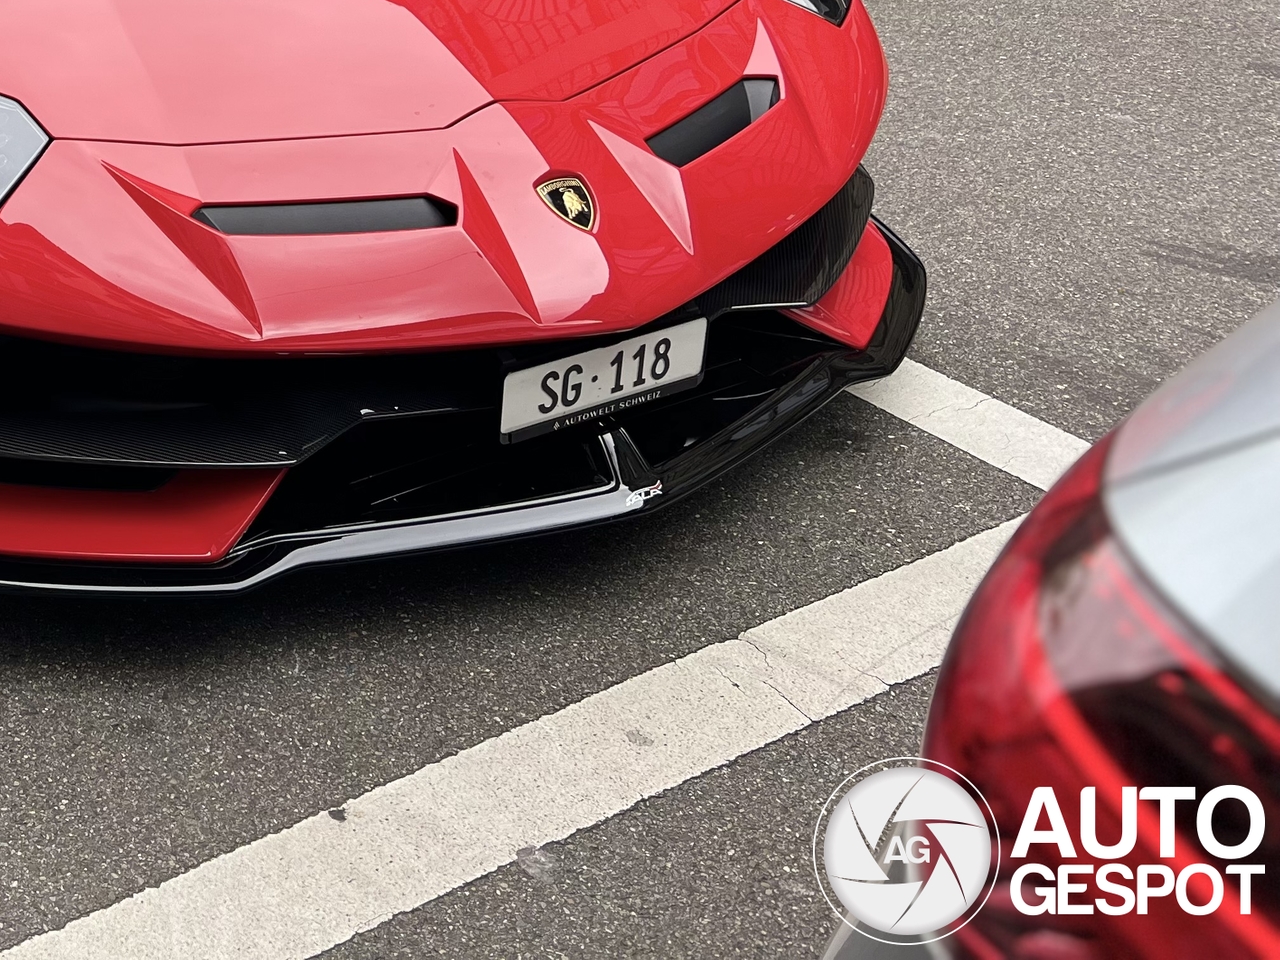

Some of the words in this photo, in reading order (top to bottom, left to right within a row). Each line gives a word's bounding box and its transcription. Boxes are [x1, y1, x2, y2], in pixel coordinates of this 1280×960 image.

[540, 180, 581, 195] LAMBORGHINI
[563, 405, 616, 427] AUTOWELT
[619, 390, 662, 409] SCHWEIZ
